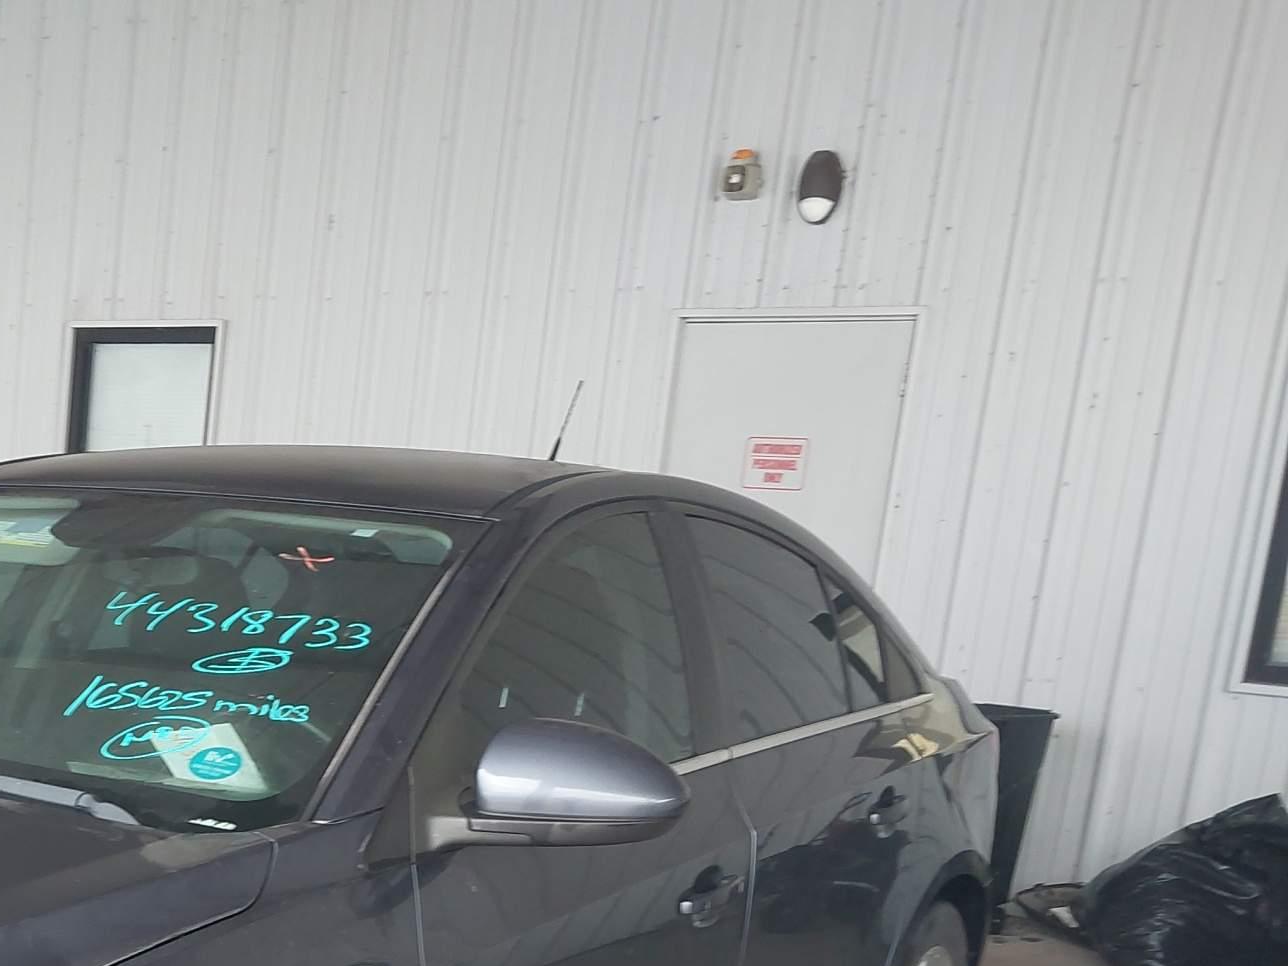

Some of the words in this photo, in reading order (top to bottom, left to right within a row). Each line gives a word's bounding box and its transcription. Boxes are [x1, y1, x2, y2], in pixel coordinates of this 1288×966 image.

[105, 591, 373, 650] 44318733
[63, 675, 212, 717] 165625
[213, 694, 310, 723] miles
